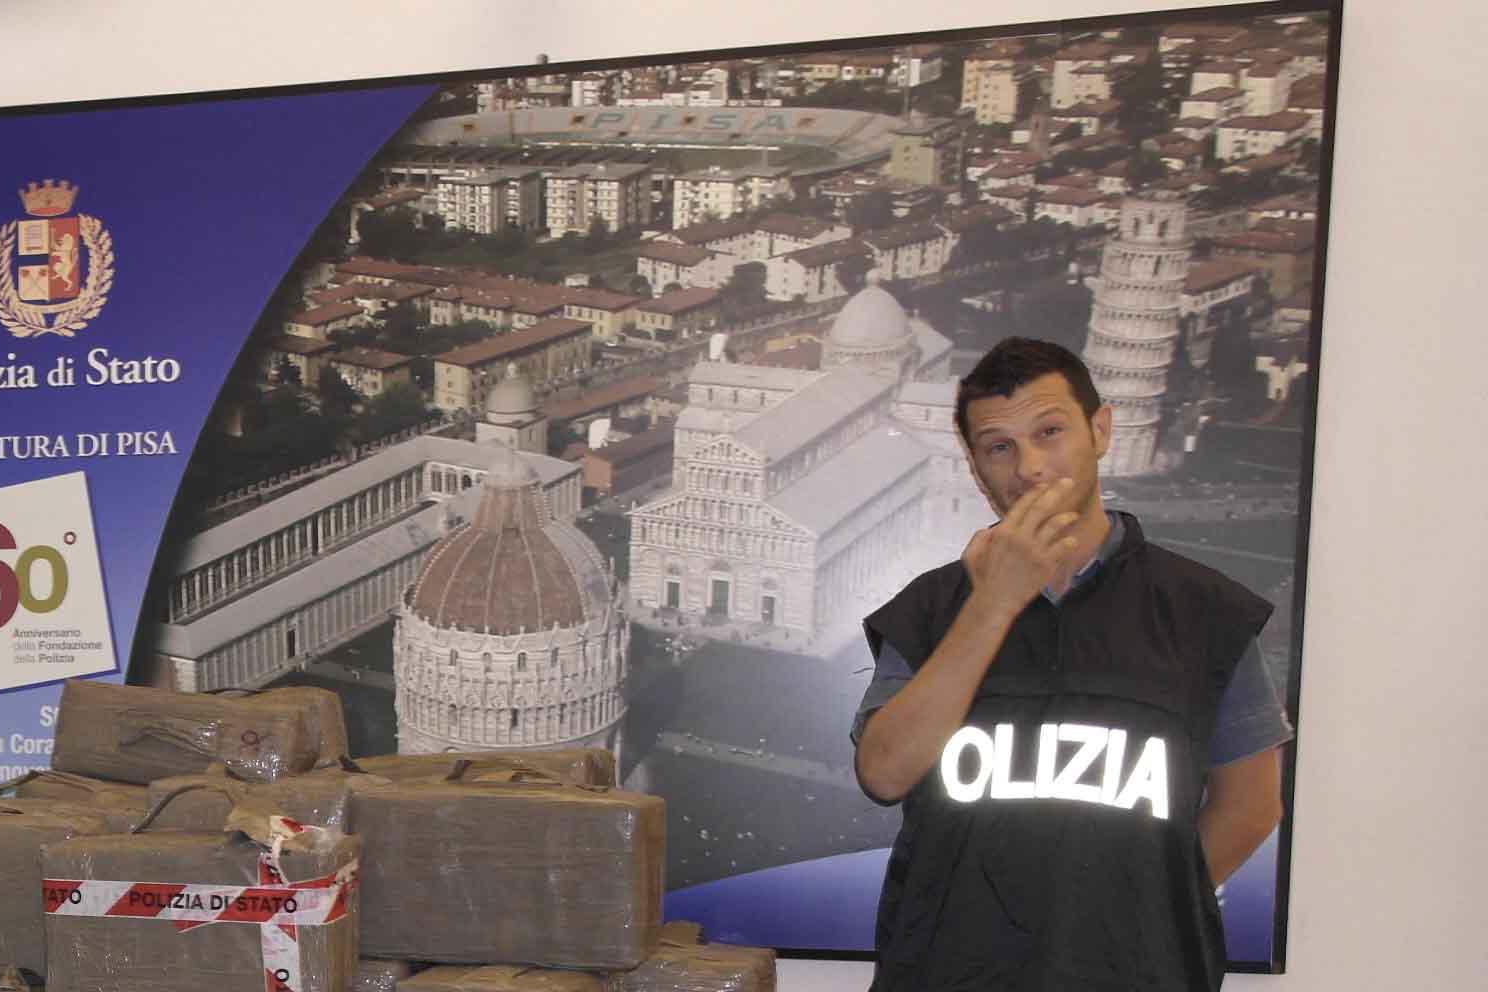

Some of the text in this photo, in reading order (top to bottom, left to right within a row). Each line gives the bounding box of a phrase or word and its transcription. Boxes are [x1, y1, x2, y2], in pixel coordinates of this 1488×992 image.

[46, 357, 76, 387] di
[85, 347, 182, 386] Stato
[75, 432, 109, 457] DI
[116, 430, 178, 456] PISA
[38, 640, 103, 651] Fondazione
[38, 653, 75, 664] Polizia
[940, 722, 1169, 819] OLIZIA
[128, 889, 204, 911] POLIZIA
[210, 894, 230, 911] DI
[237, 895, 299, 915] STATO
